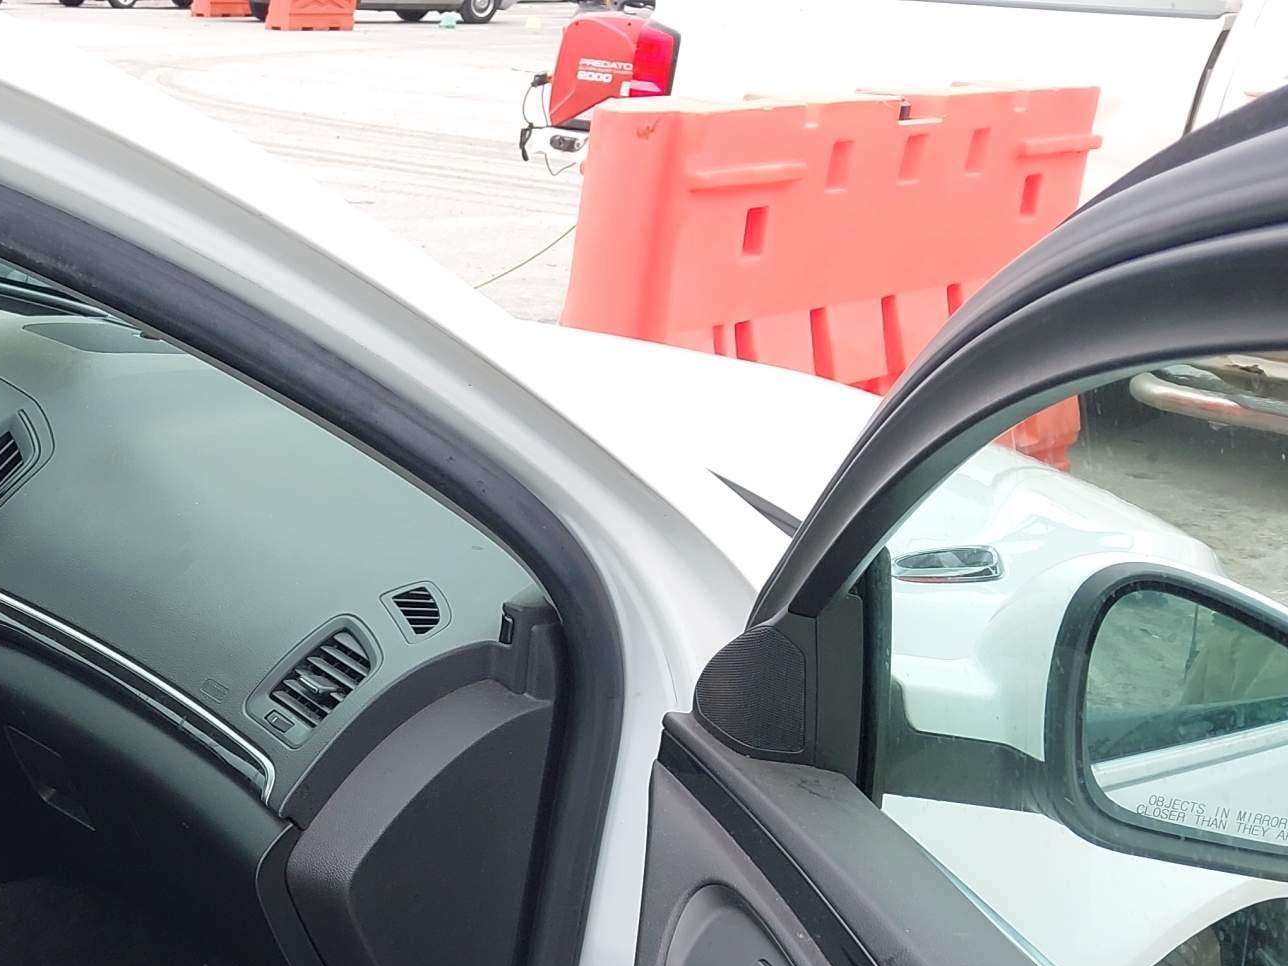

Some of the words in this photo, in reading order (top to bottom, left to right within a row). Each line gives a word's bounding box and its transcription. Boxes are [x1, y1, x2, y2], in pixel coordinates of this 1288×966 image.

[577, 71, 613, 82] 2000
[1136, 804, 1186, 822] CLOSER
[1195, 815, 1227, 830] THAN
[1237, 822, 1269, 837] THEY
[1275, 830, 1288, 841] A
[1148, 794, 1206, 814] OBJECTS
[1215, 807, 1230, 819] IN
[1237, 810, 1288, 829] MIRROR
